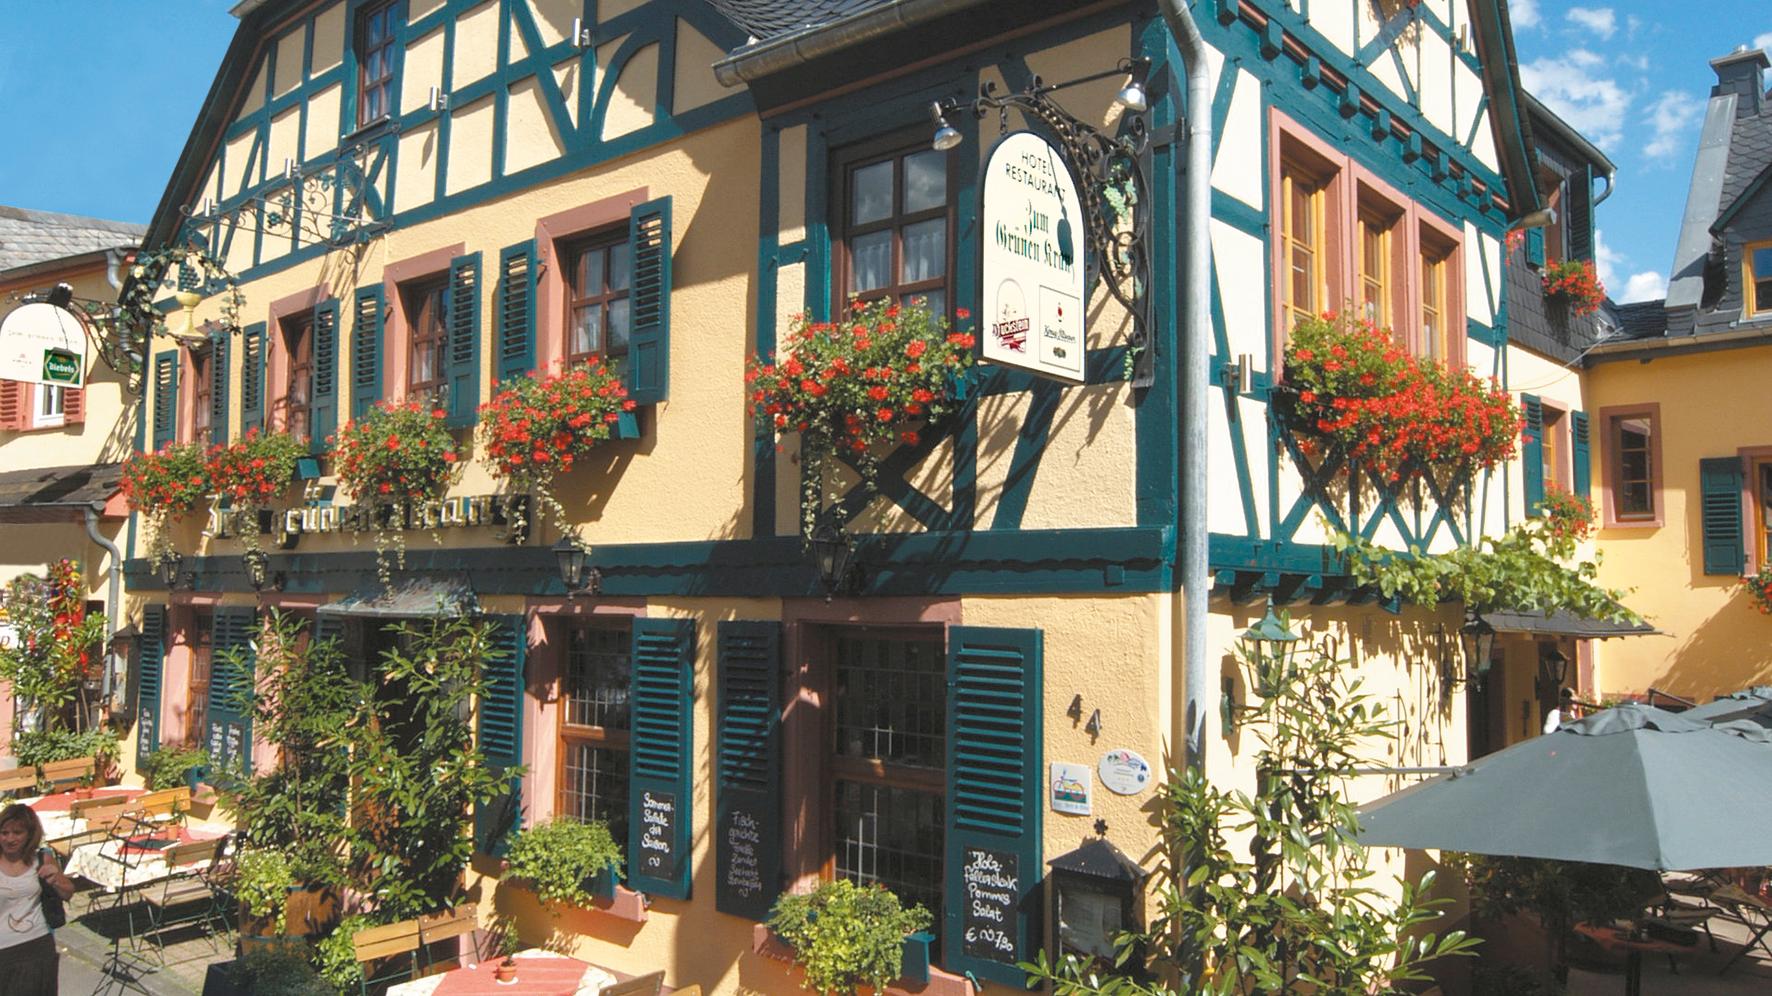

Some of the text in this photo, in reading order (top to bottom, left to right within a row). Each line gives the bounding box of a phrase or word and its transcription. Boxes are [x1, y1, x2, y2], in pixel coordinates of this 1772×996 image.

[1005, 162, 1066, 202] RESTAURANT
[1021, 151, 1052, 177] HOTEL
[1024, 199, 1049, 236] Zum
[995, 219, 1040, 262] Grünen
[1066, 694, 1101, 743] 44
[967, 882, 1011, 906] Pommes
[972, 899, 1004, 923] Salat
